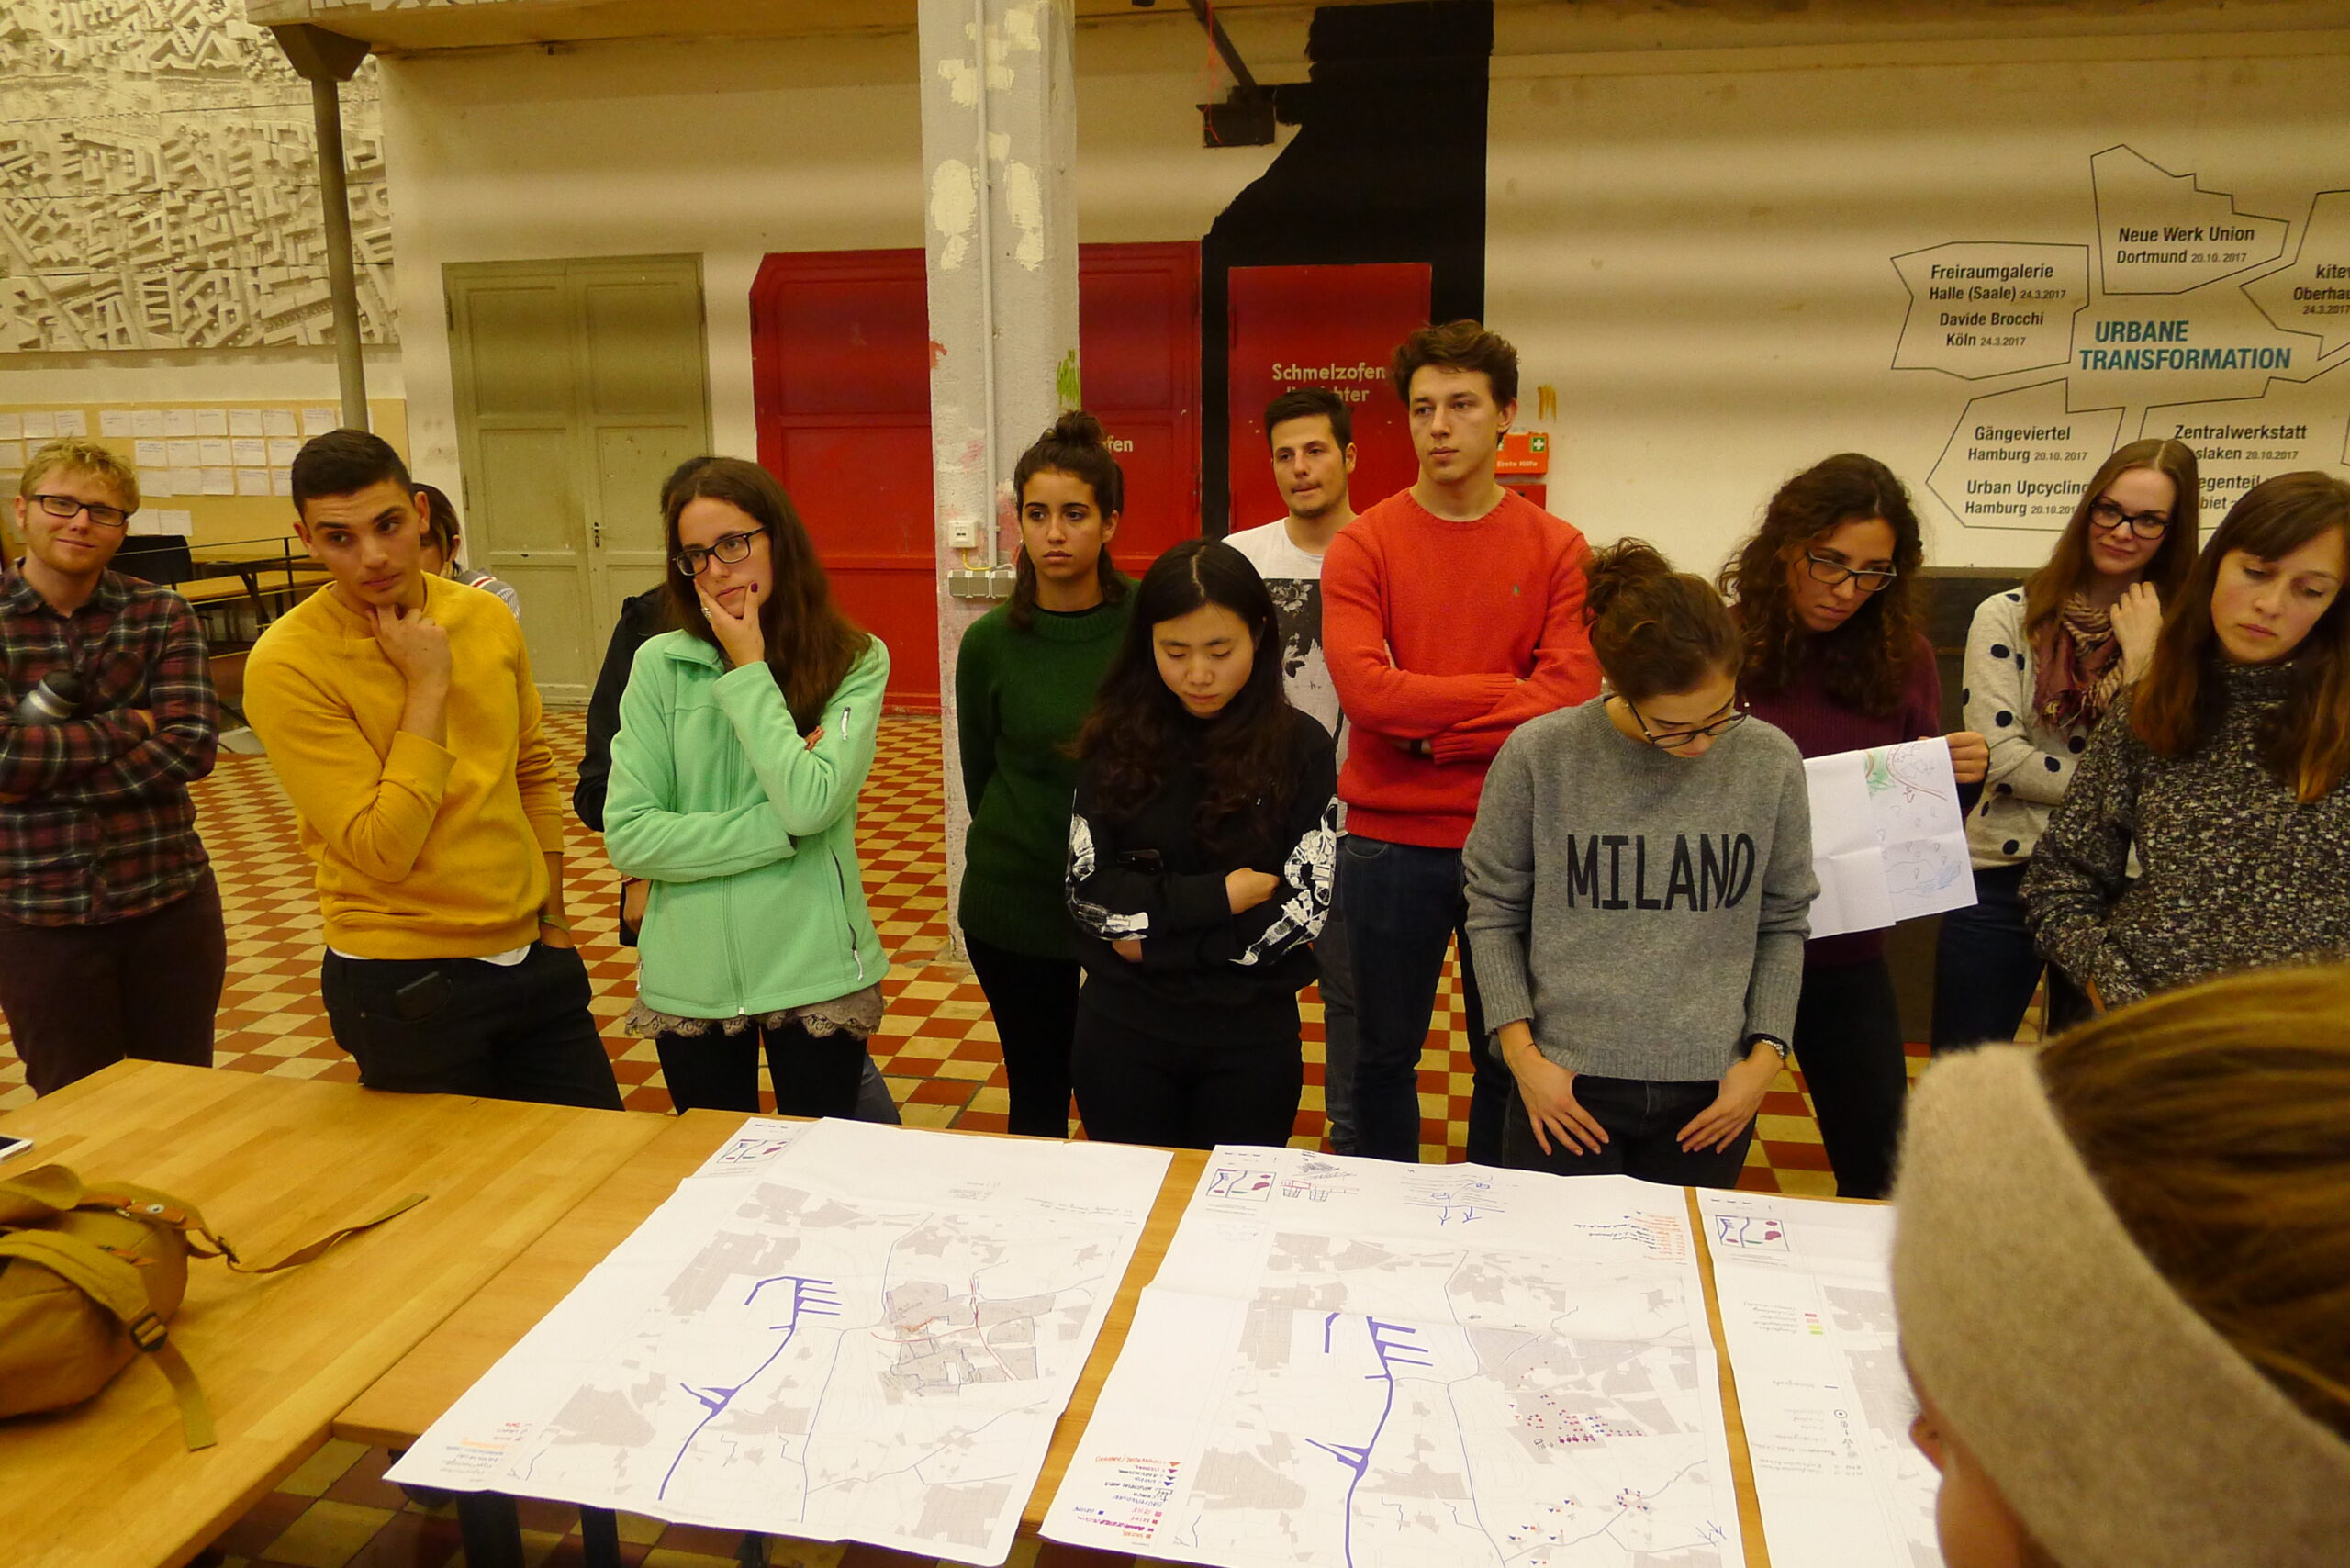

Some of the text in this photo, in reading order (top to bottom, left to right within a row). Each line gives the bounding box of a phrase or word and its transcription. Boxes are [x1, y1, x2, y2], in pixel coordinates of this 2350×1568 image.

[2119, 226, 2255, 242] Neue Werk Union
[2117, 250, 2188, 263] Dortmund
[1931, 263, 2054, 282] Freiraumgalerie
[1929, 286, 2067, 302] Halle (Saale) 24.3.2017
[1940, 312, 2044, 326] Davide Brocchi
[2095, 320, 2189, 342] URBANE
[1946, 333, 2027, 346] Köln 24.3.2017
[2079, 348, 2292, 371] TRANSFORMATION
[1272, 362, 1386, 383] Schmelzofen
[1975, 426, 2071, 443] Gängeviertel
[2174, 425, 2308, 440] Zentralwerkstatt
[1968, 448, 2031, 463] Hamburg
[2195, 447, 2299, 460] slaken 20.10.2017
[1967, 479, 2011, 494] Urban
[2199, 474, 2261, 490] egenteil
[1965, 501, 2076, 517] Hamburg 20.10.201
[2200, 497, 2227, 510] biet
[1567, 833, 1755, 912] MILANO
